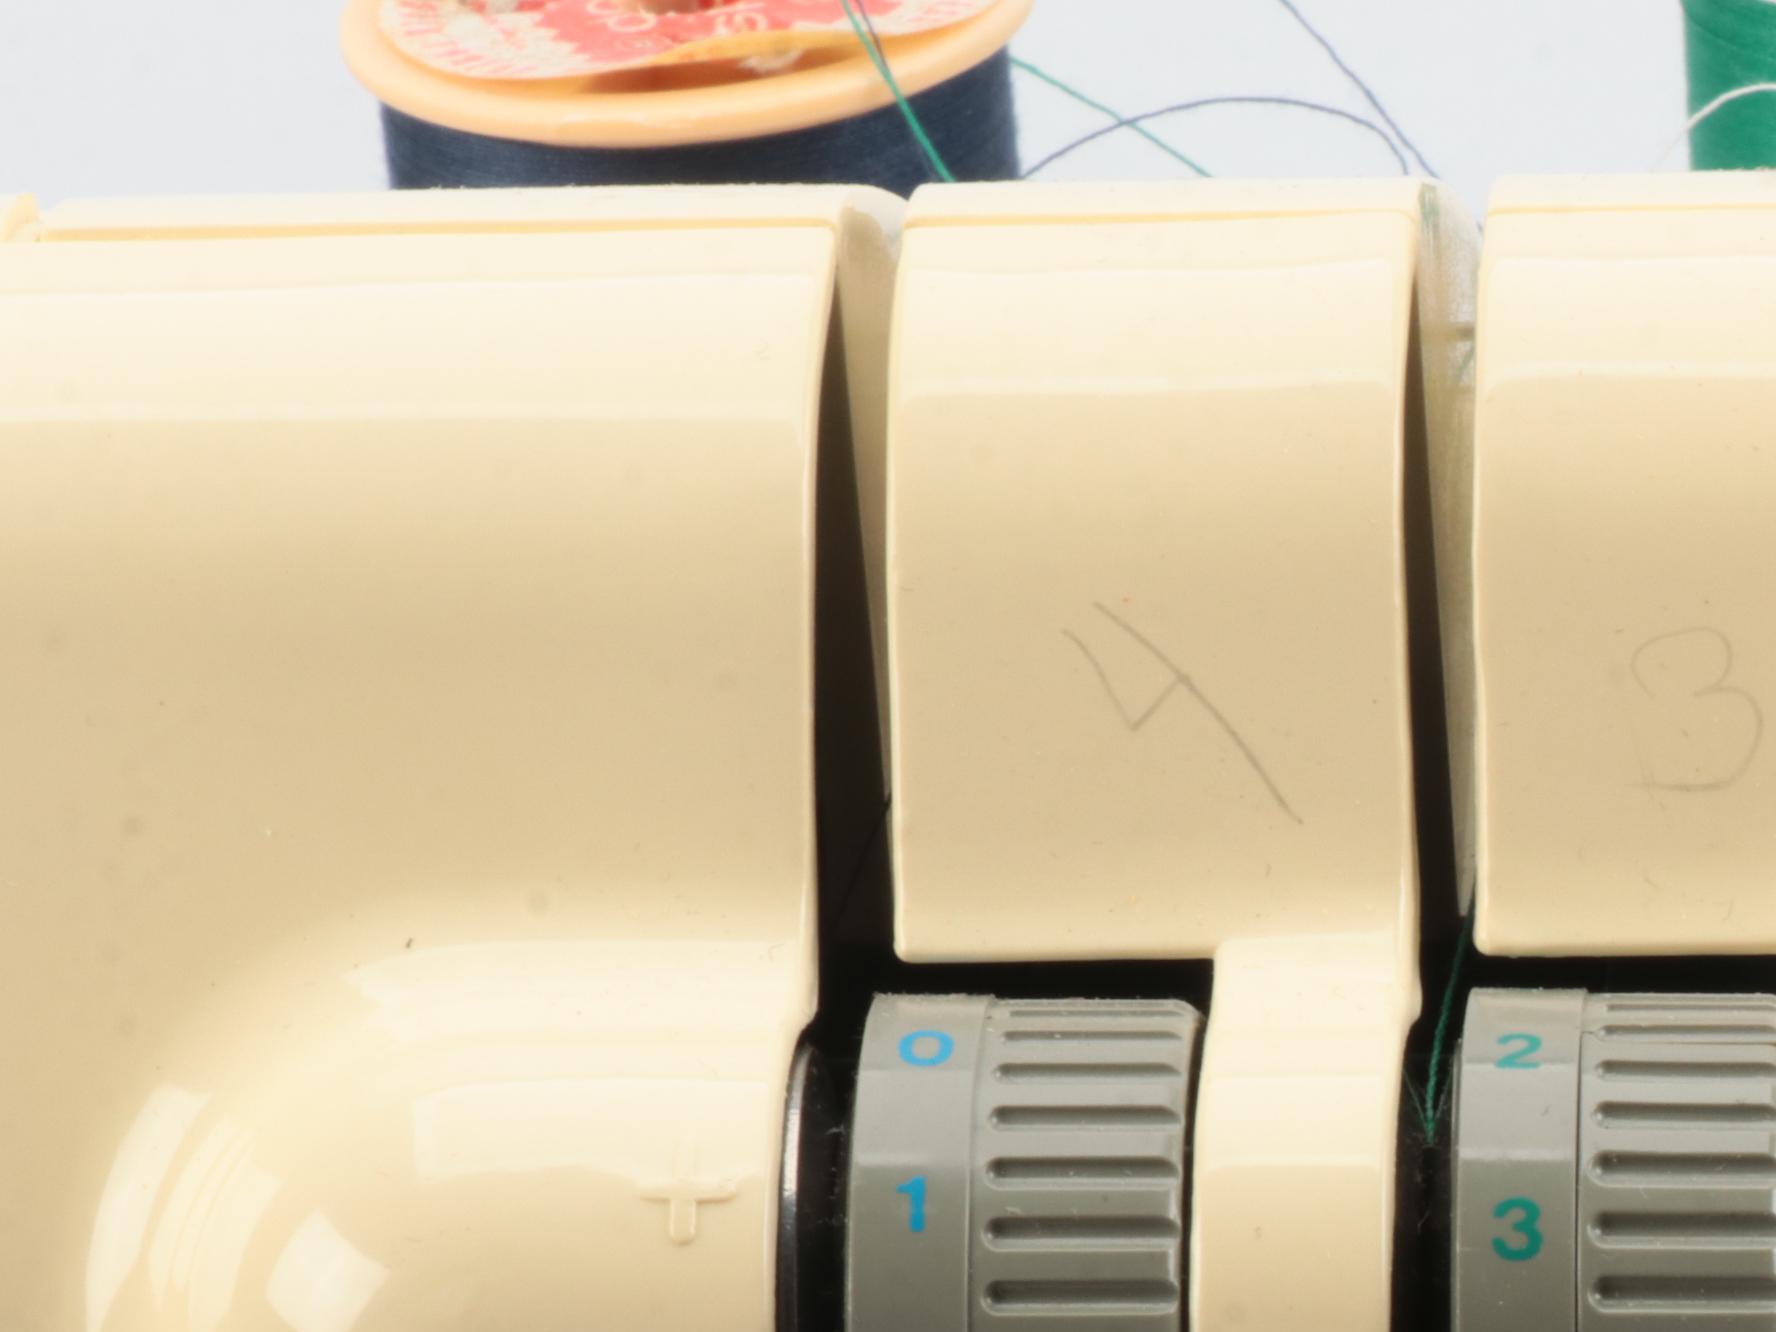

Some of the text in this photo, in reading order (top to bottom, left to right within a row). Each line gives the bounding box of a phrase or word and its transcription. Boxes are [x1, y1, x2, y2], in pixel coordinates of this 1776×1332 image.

[897, 1029, 955, 1068] 0
[1495, 1032, 1543, 1071] 2
[896, 1174, 928, 1233] 1
[1490, 1195, 1545, 1263] 3
